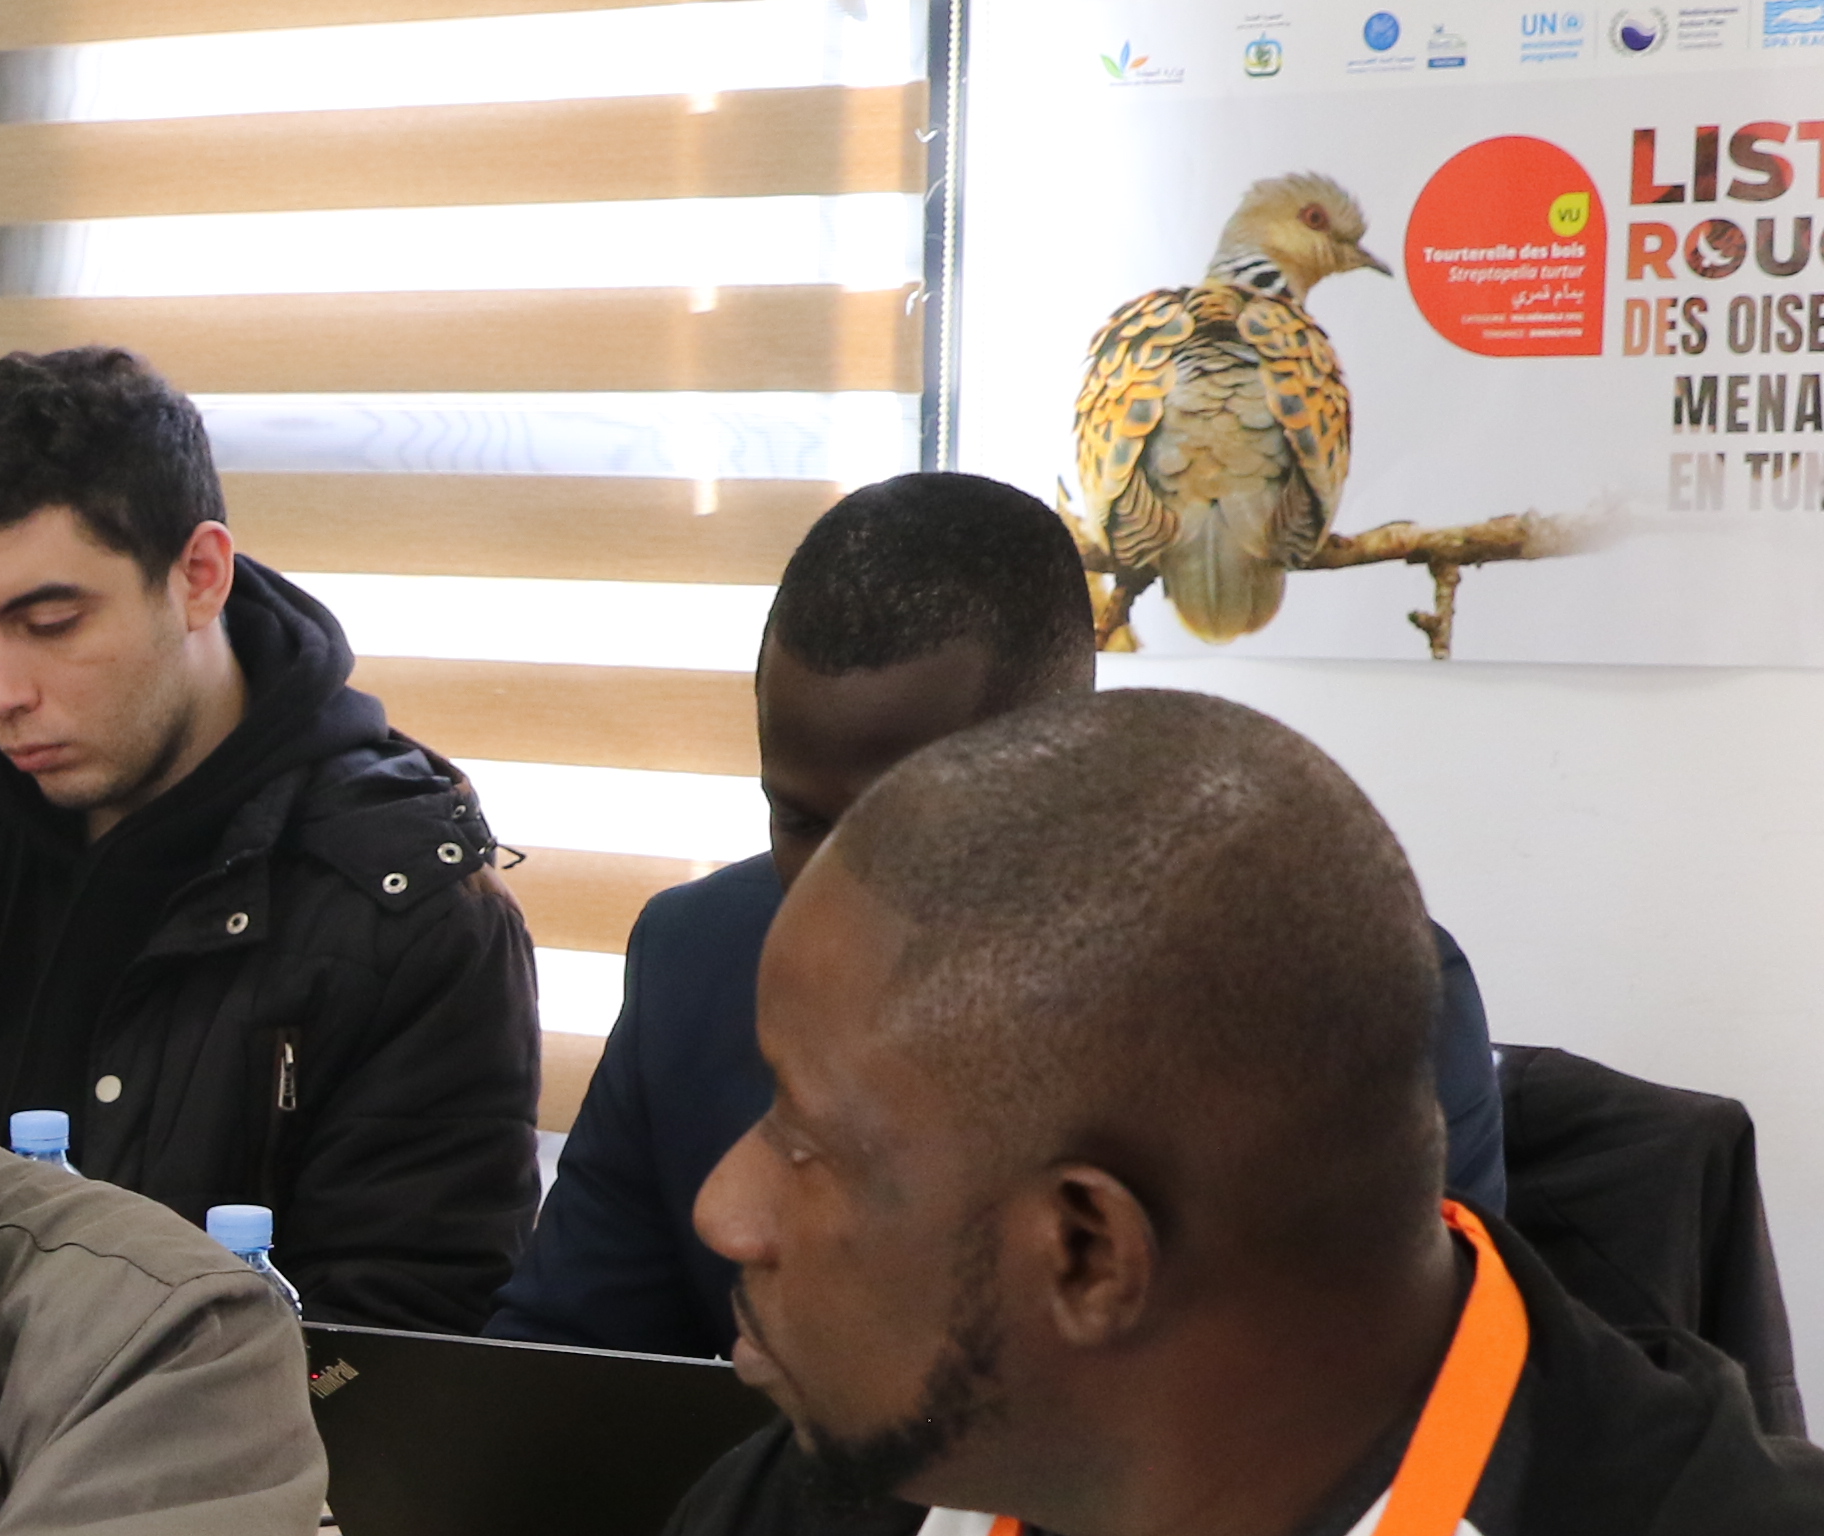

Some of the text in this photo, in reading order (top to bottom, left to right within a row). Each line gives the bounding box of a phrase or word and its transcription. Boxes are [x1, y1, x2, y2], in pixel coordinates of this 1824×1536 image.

[1522, 13, 1558, 36] UN
[1557, 207, 1582, 223] VU
[1423, 241, 1587, 263] Tourterelle des bois
[1626, 217, 1824, 281] ROU
[1623, 296, 1709, 357] DES
[1667, 451, 1727, 513] EN
